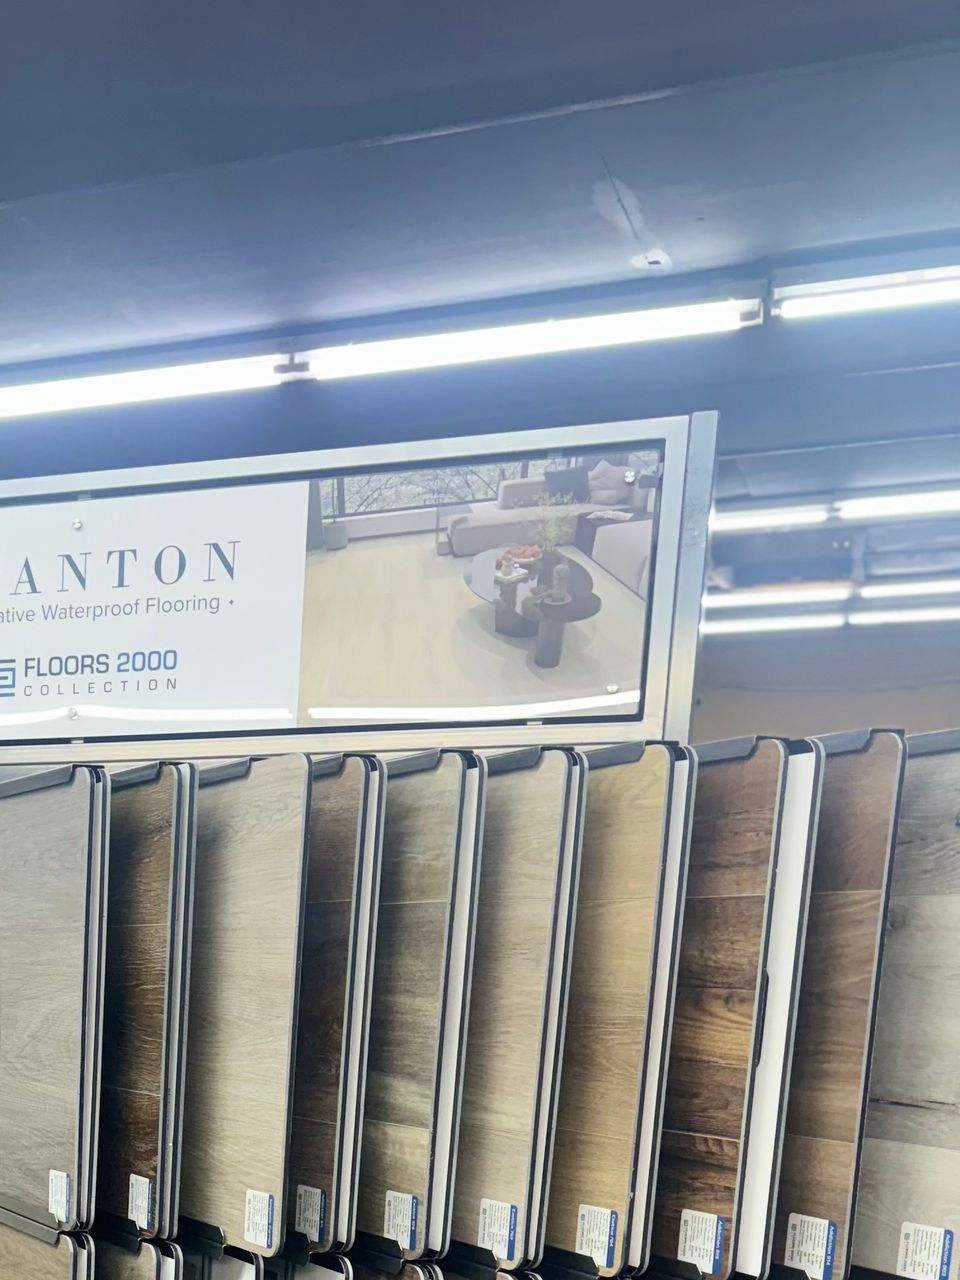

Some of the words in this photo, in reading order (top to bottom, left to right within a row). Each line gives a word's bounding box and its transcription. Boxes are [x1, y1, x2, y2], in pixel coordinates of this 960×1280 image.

[42, 599, 141, 622] Waterproof
[145, 595, 221, 615] Flooring
[24, 653, 110, 678] FLOORS
[116, 649, 178, 673] 2000
[23, 677, 177, 697] COLLECTION
[943, 1234, 951, 1263] Addiction
